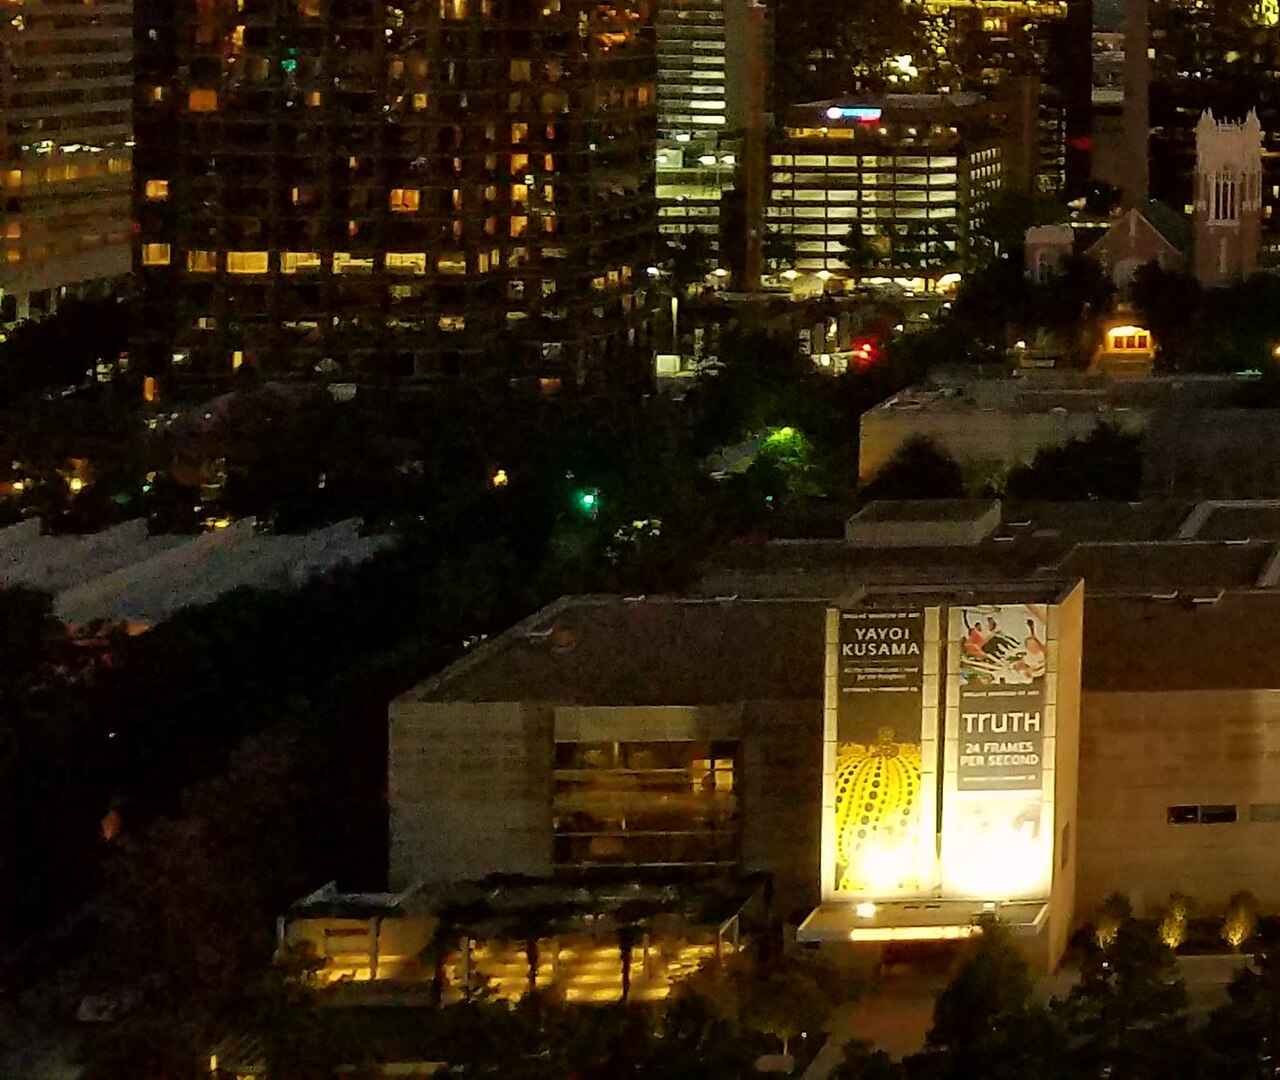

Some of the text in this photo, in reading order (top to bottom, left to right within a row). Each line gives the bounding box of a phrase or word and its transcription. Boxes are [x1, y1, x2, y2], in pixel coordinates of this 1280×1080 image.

[855, 627, 910, 640] YAYOI
[842, 642, 920, 656] KUSAMA
[965, 741, 1034, 754] 24 FRAMES
[959, 753, 1040, 767] PER SECOND
